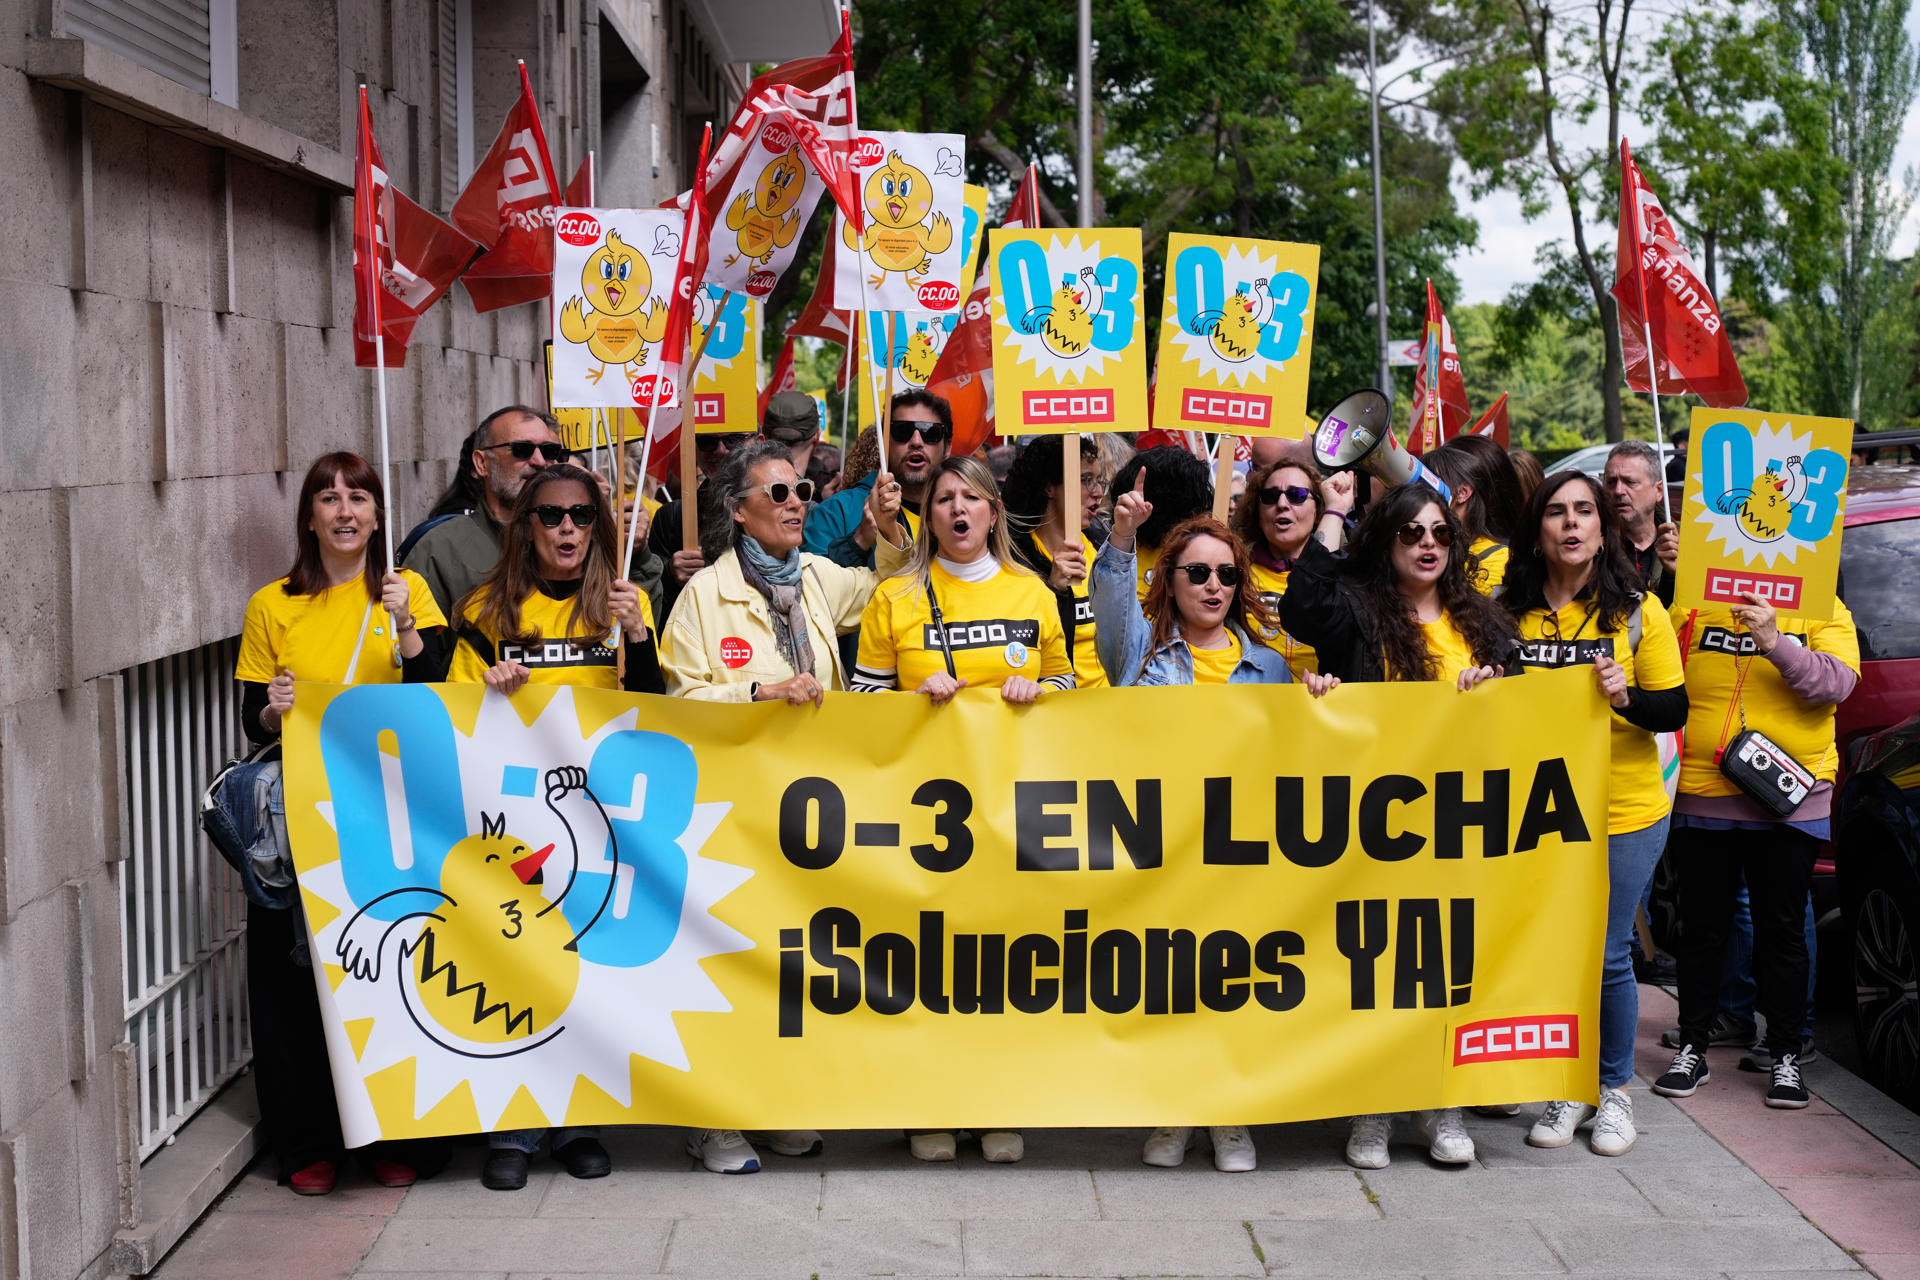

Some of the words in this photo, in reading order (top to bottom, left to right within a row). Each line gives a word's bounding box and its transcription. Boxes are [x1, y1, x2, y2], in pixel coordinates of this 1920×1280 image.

[557, 218, 599, 236] CC.OO.
[918, 286, 959, 302] CC.OO.
[998, 239, 1138, 352] 0-3
[1174, 246, 1310, 362] 0-3
[633, 382, 673, 398] CC.O.
[1029, 396, 1108, 417] CCOO
[1187, 396, 1266, 420] CCOO
[1701, 421, 1847, 543] 0-3
[1711, 576, 1795, 602] CCOO
[1705, 631, 1760, 652] CCO
[319, 683, 699, 968] 0-3
[778, 776, 975, 873] 0-3
[1014, 779, 1163, 872] EN
[1203, 757, 1592, 868] LUCHA
[778, 906, 1306, 1038] ¡Soluciones
[1336, 898, 1475, 1011] YA!
[1460, 1023, 1570, 1057] CCOO
